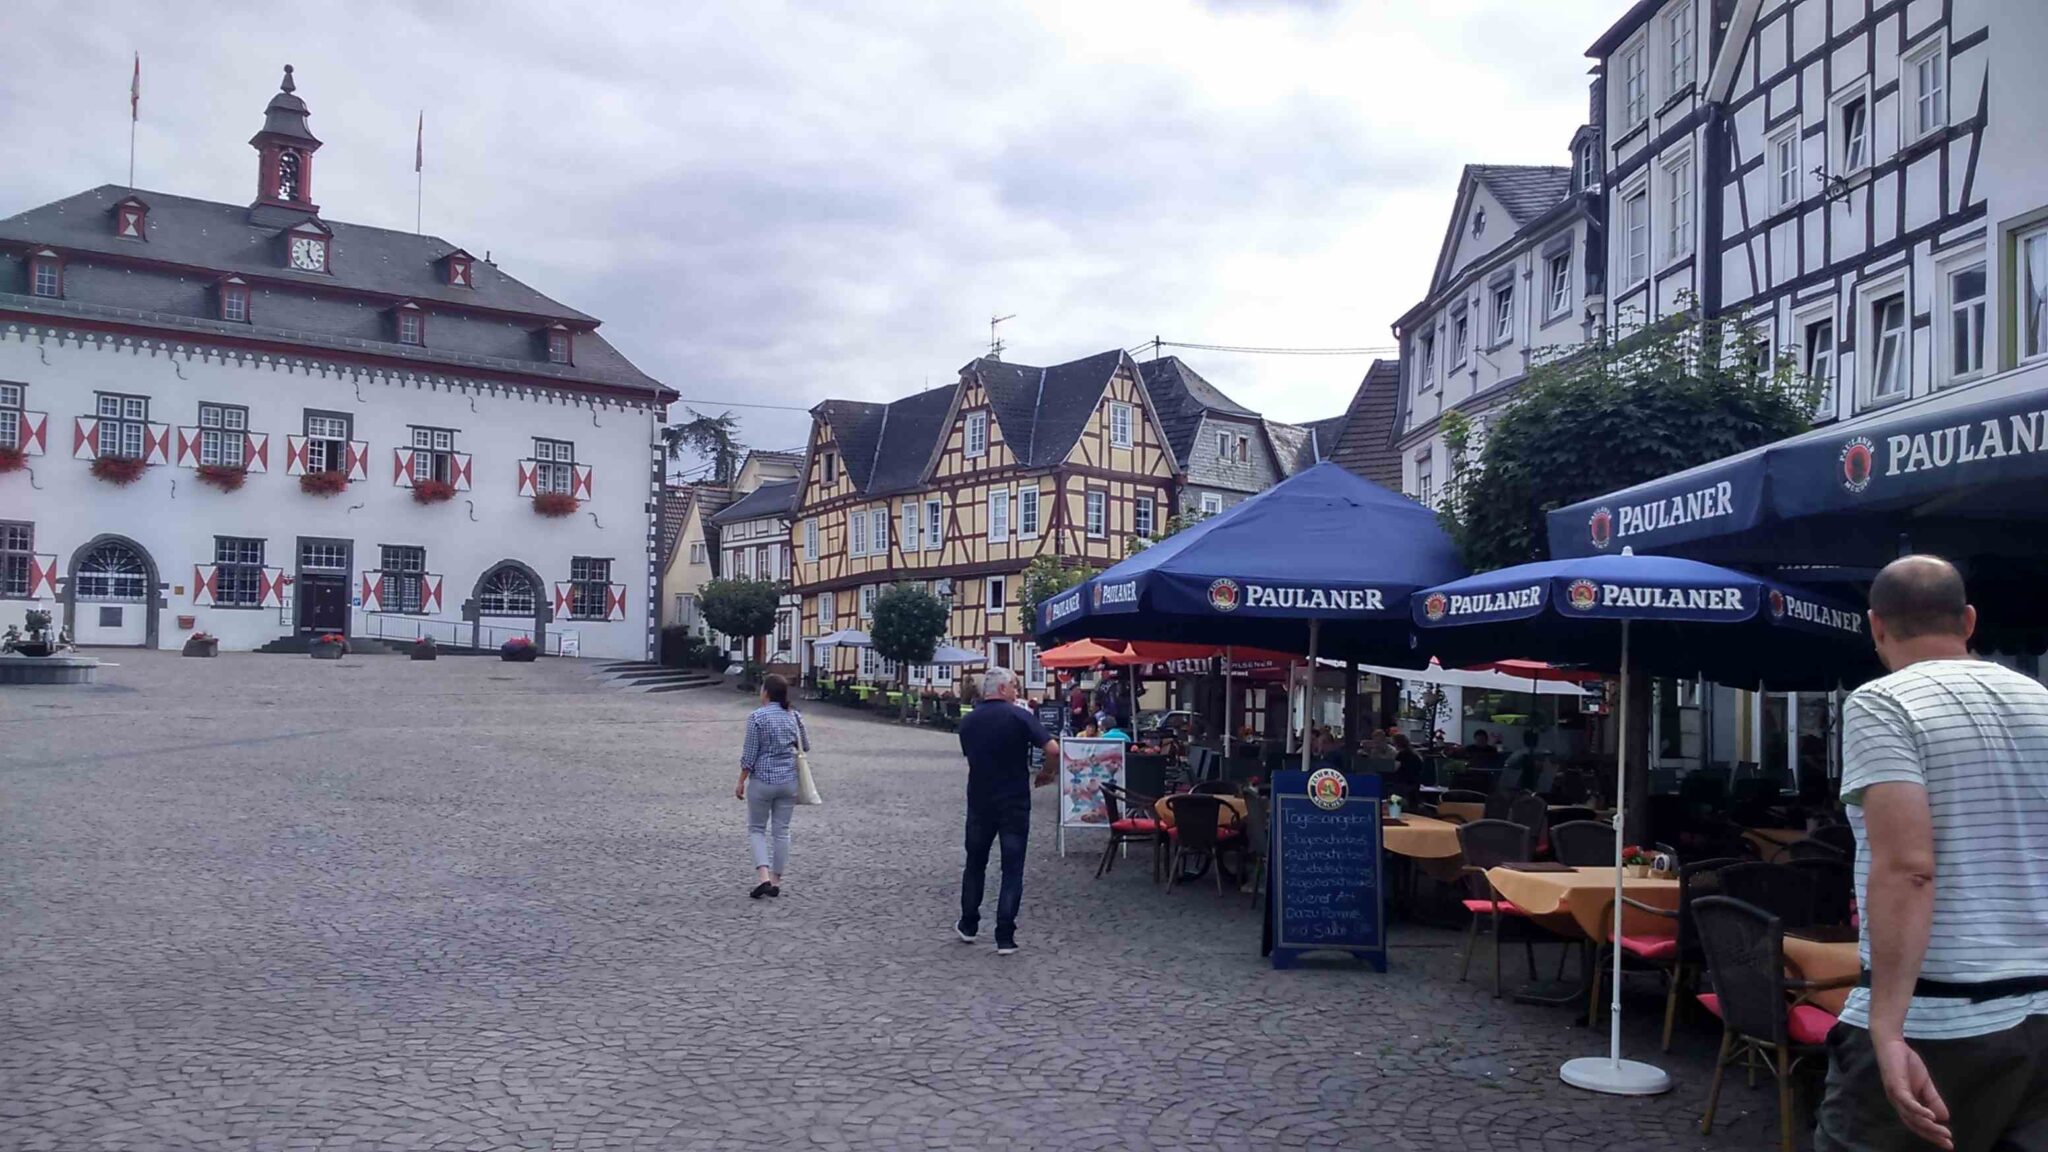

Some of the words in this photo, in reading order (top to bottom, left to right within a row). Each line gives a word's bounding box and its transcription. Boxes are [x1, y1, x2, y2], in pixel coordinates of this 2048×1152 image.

[1617, 481, 1733, 537] PAULANER
[1102, 581, 1137, 604] PAULANER
[1245, 585, 1385, 610] PAULANER
[1449, 585, 1541, 615] PAULANER
[1602, 584, 1744, 610] PAULANER
[1052, 593, 1080, 621] PAULANER
[1785, 595, 1862, 634] PAULANER
